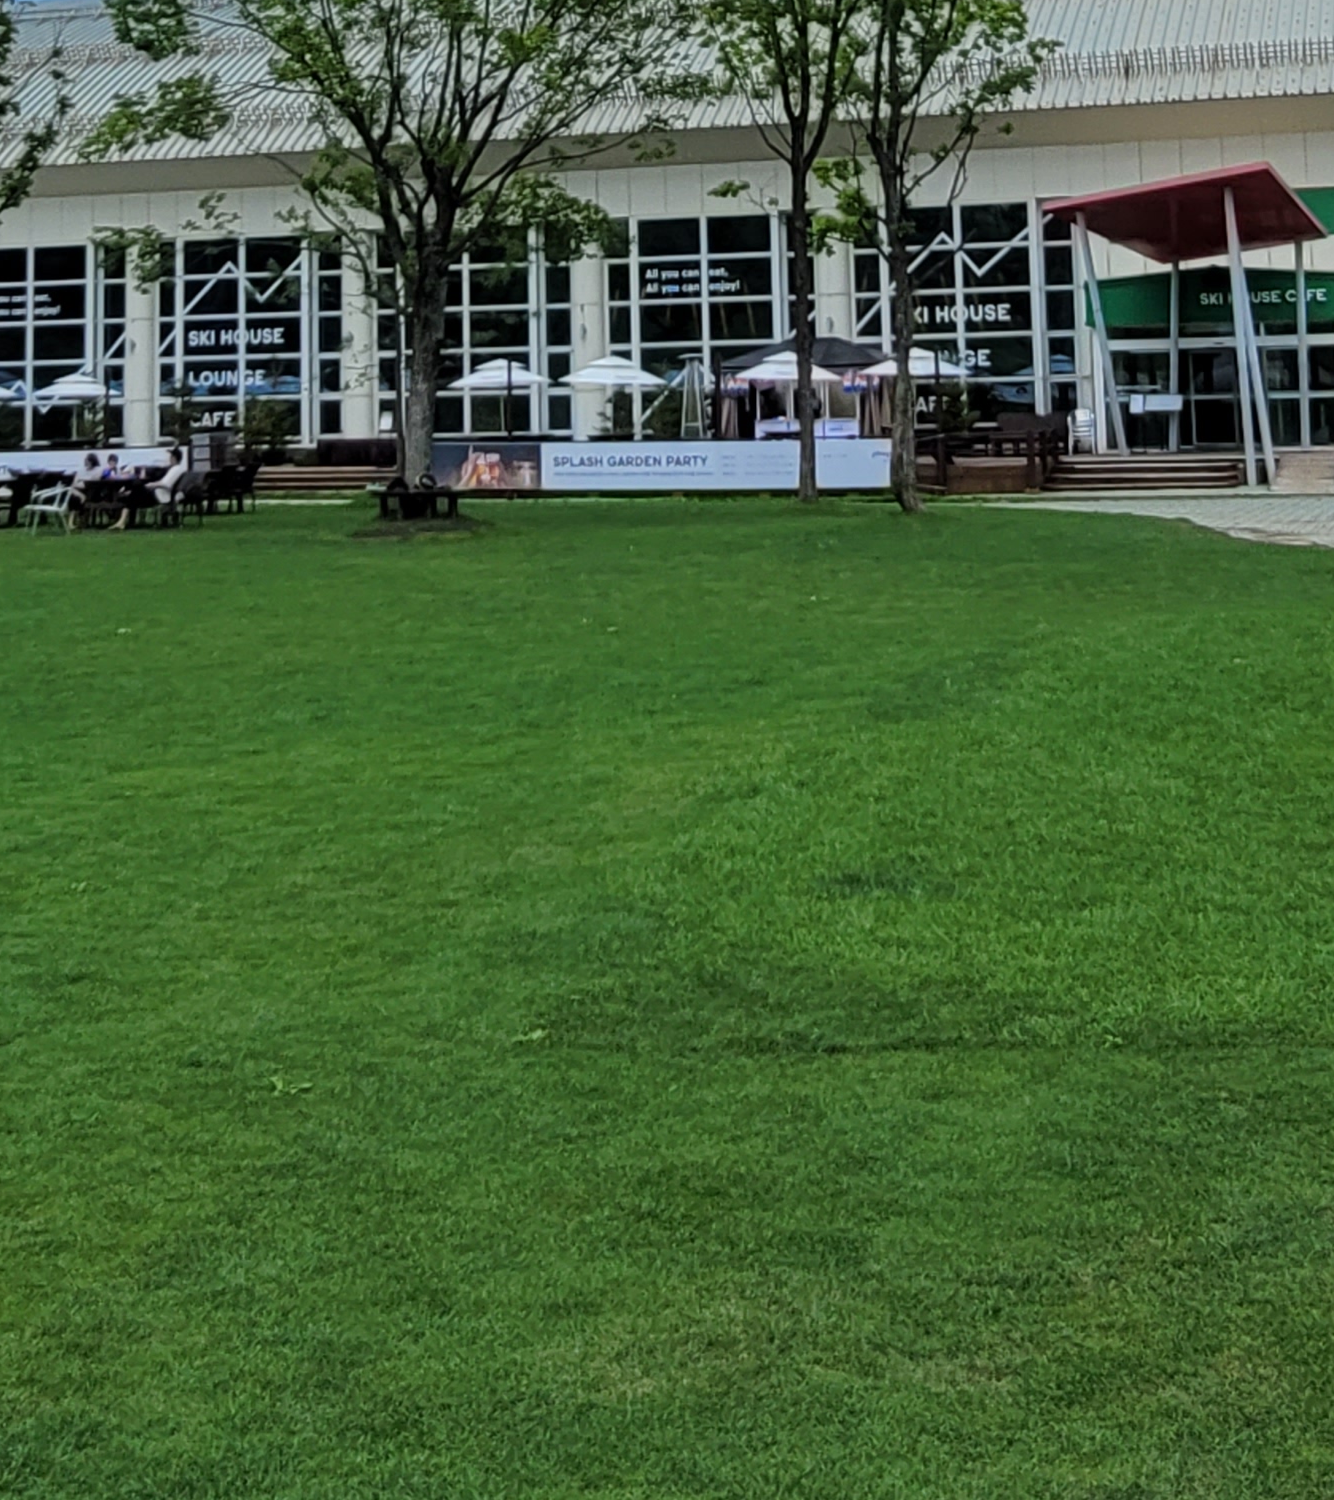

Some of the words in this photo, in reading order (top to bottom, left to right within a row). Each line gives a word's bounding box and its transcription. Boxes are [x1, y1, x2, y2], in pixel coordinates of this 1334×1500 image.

[660, 270, 679, 281] you
[681, 269, 700, 278] can
[681, 283, 700, 292] can
[1199, 293, 1223, 306] SKI
[1228, 290, 1282, 305] USE
[1284, 288, 1327, 302] CFE
[935, 303, 1011, 324] HOUSE
[188, 330, 216, 347] SKI
[219, 327, 285, 346] HOUSE
[188, 369, 266, 387] LOUNGE
[553, 455, 603, 468] SPLASH
[607, 455, 662, 468] GARDEN
[666, 455, 708, 468] PARTY
